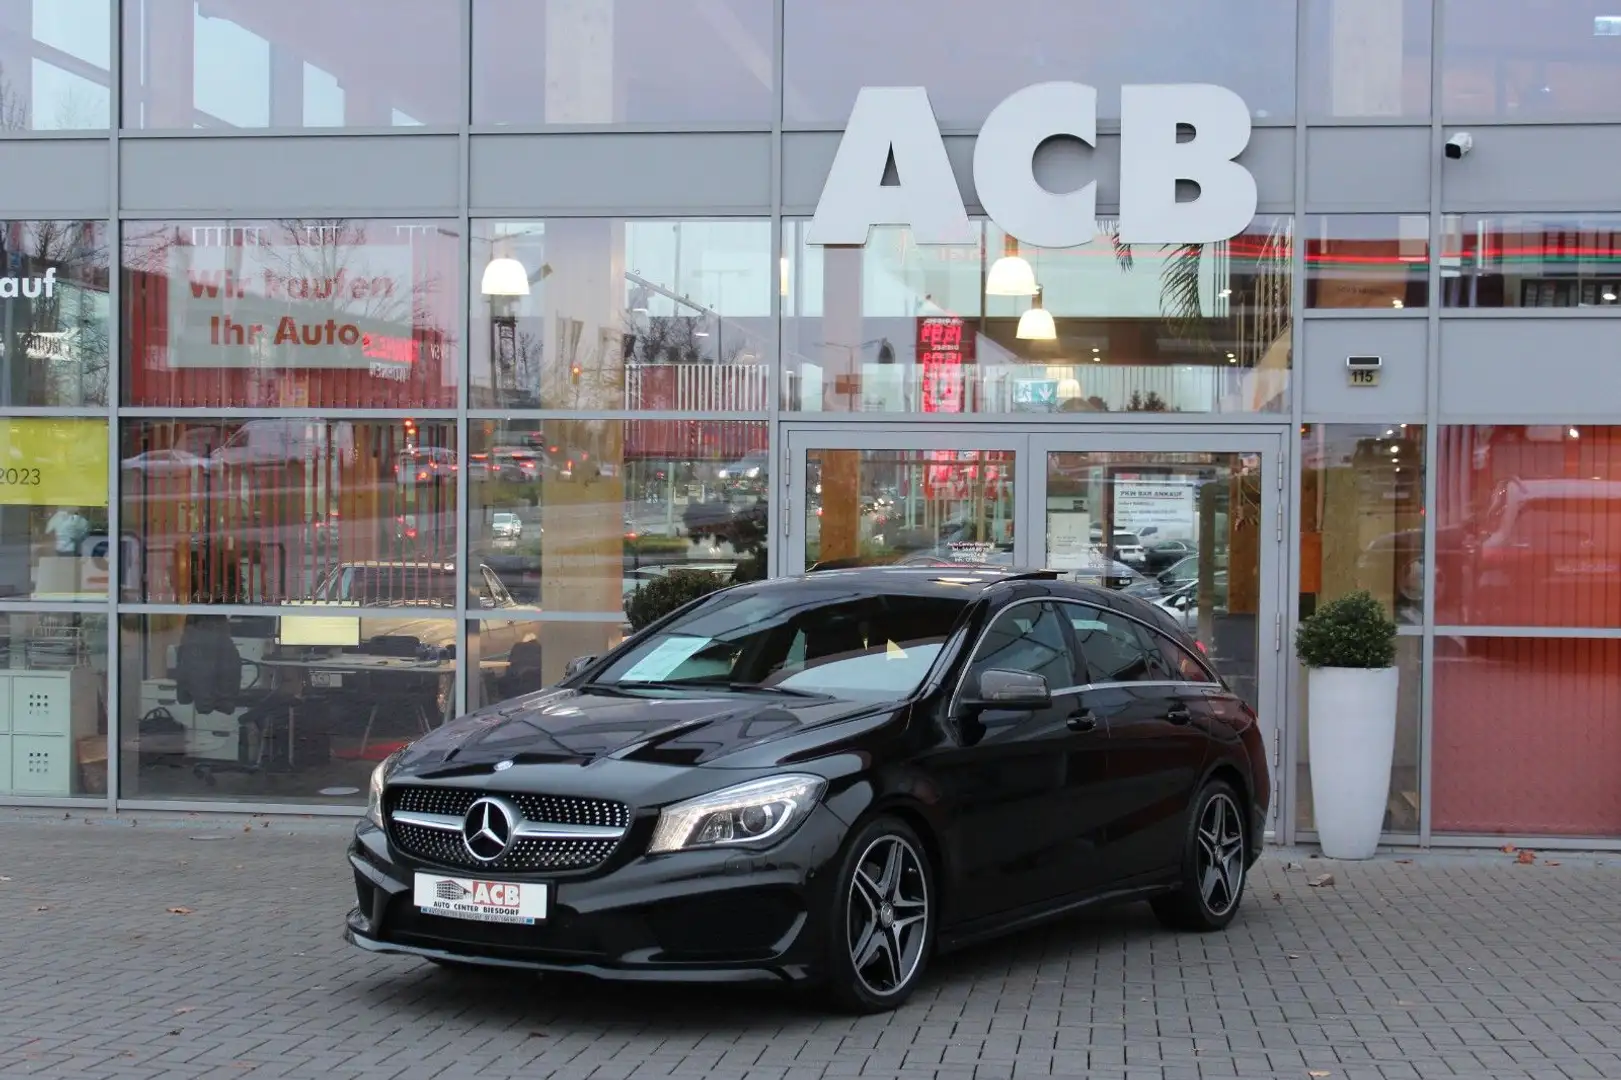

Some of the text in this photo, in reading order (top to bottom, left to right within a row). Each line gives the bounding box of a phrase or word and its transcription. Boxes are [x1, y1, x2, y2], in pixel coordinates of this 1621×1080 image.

[805, 81, 1257, 248] ACB
[187, 267, 393, 299] Wir kaufen
[210, 315, 263, 345] Ihr
[1351, 370, 1373, 383] 115
[433, 901, 520, 916] AUTO CENTER BIESDORF
[473, 883, 520, 907] ACB
